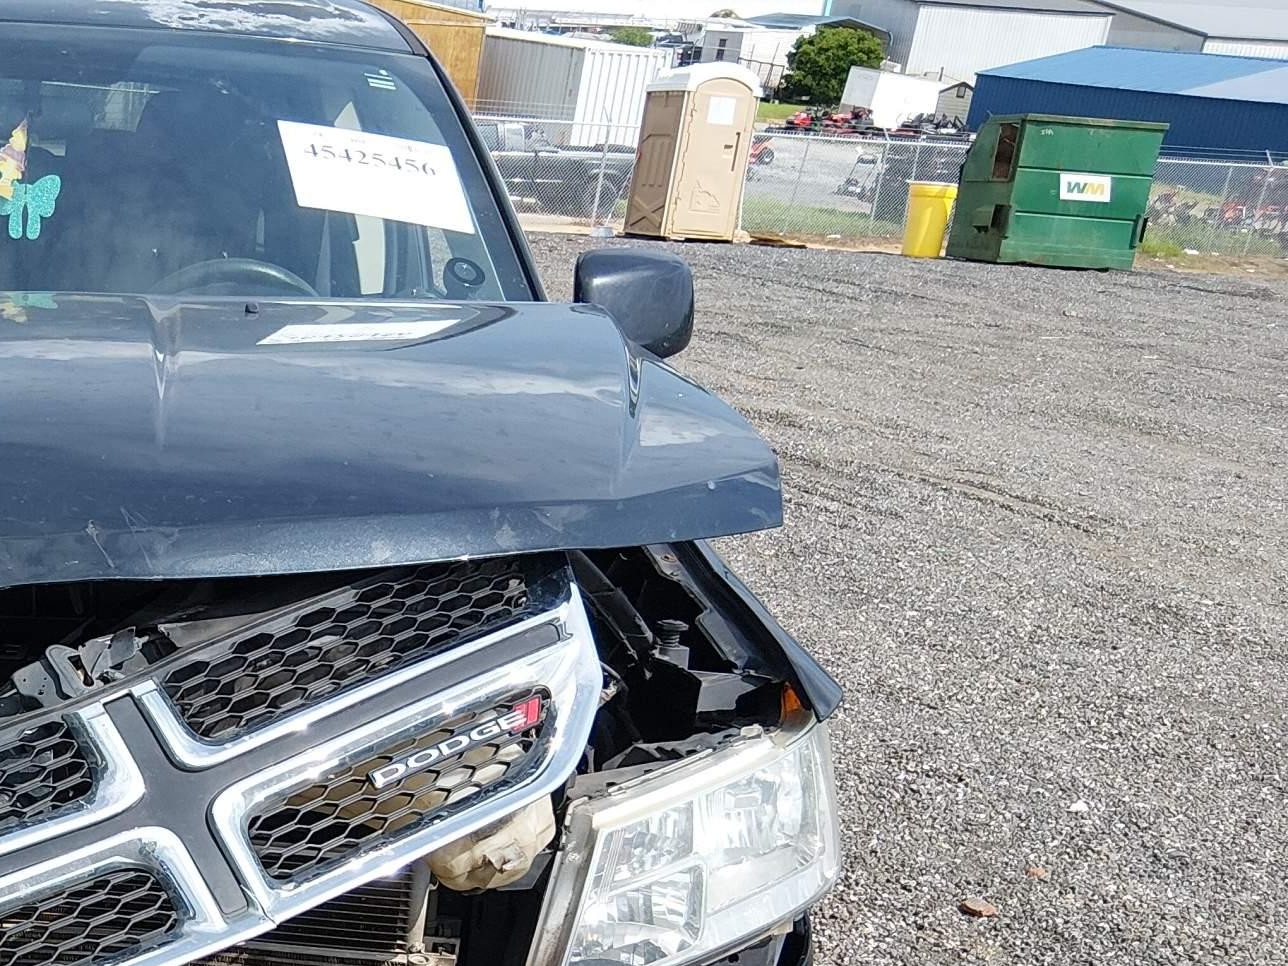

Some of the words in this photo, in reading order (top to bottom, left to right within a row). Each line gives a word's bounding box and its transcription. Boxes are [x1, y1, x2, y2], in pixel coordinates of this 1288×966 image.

[303, 143, 437, 176] 45425456
[1066, 180, 1105, 196] WM
[372, 709, 527, 789] DODGE
